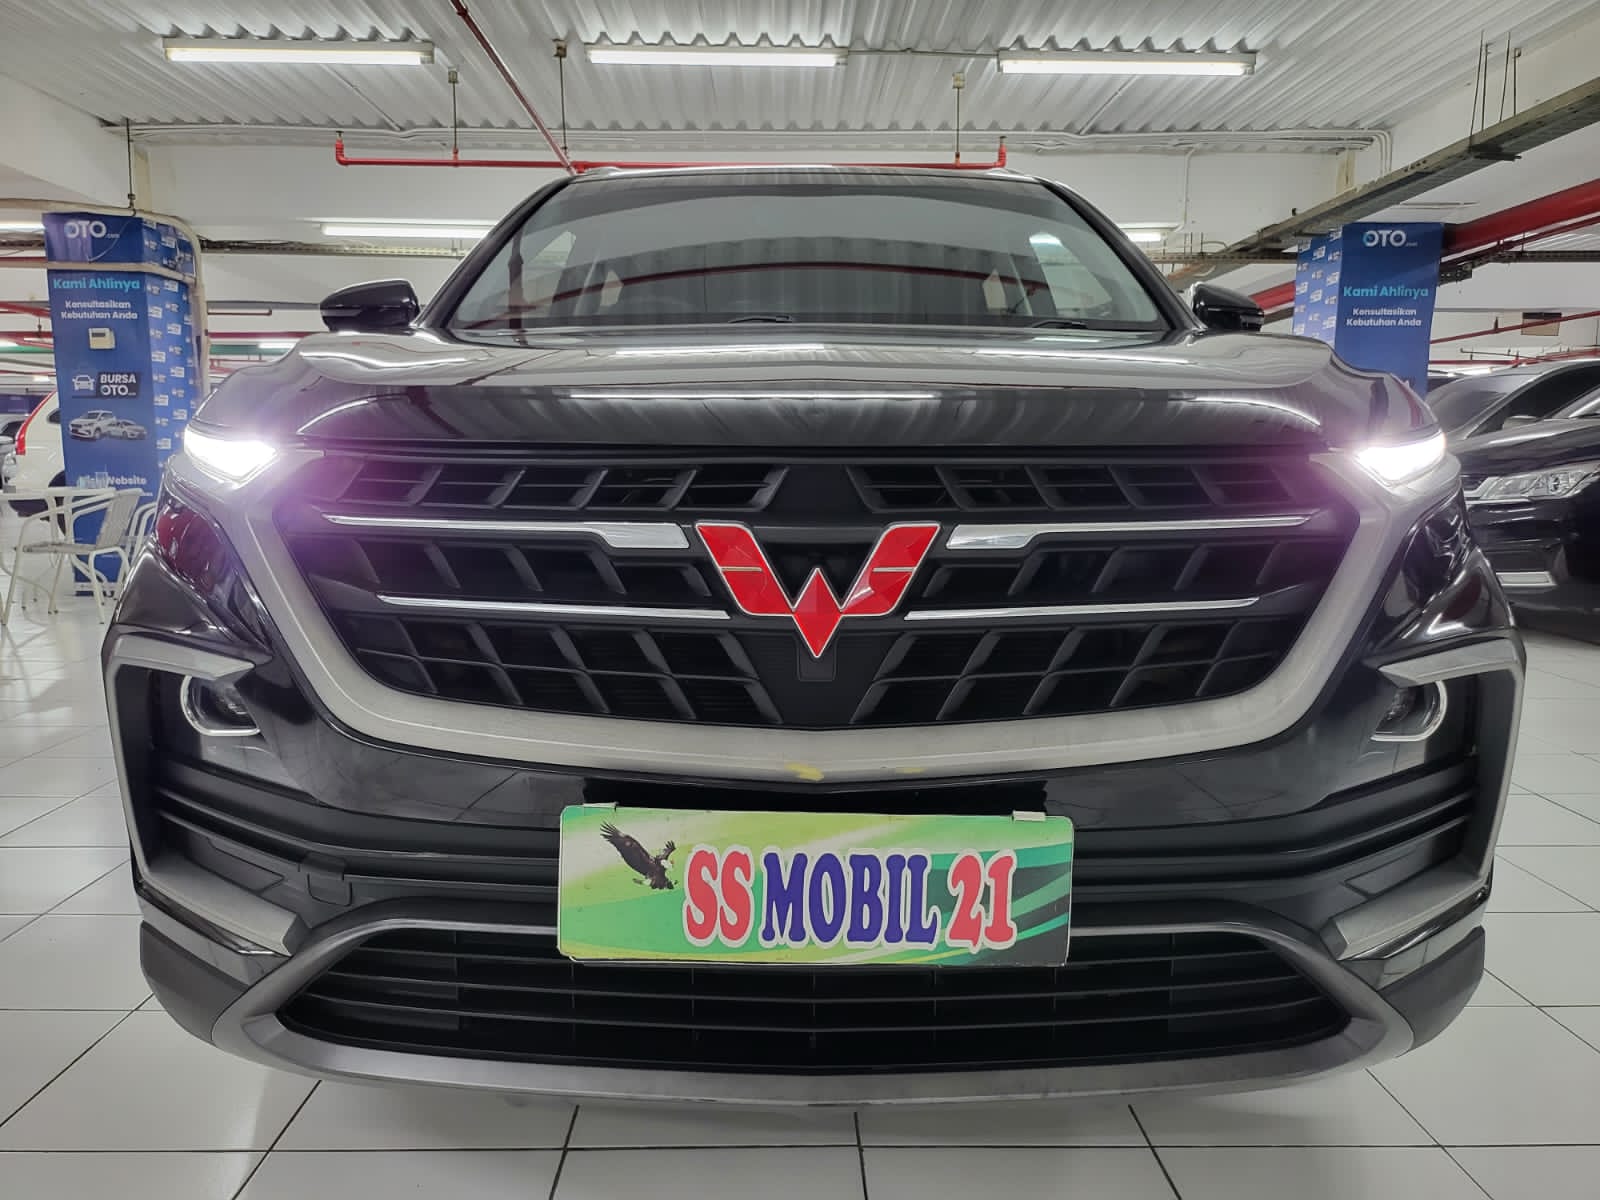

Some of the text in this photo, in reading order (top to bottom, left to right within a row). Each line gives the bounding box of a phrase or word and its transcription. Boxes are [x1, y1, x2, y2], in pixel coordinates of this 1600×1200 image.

[53, 278, 87, 289] Kami
[89, 278, 140, 292] Ahlinya
[1343, 285, 1428, 299] Kami Ahlinya
[65, 300, 131, 309] Konsultasikan
[61, 311, 138, 319] Kebutuhan Anda
[1353, 307, 1417, 316] Konsultasikan
[1346, 318, 1396, 327] Kebutuhan
[1397, 318, 1422, 326] Anda
[100, 374, 137, 384] BURSA
[683, 845, 1018, 953] SS MOBIL 21
